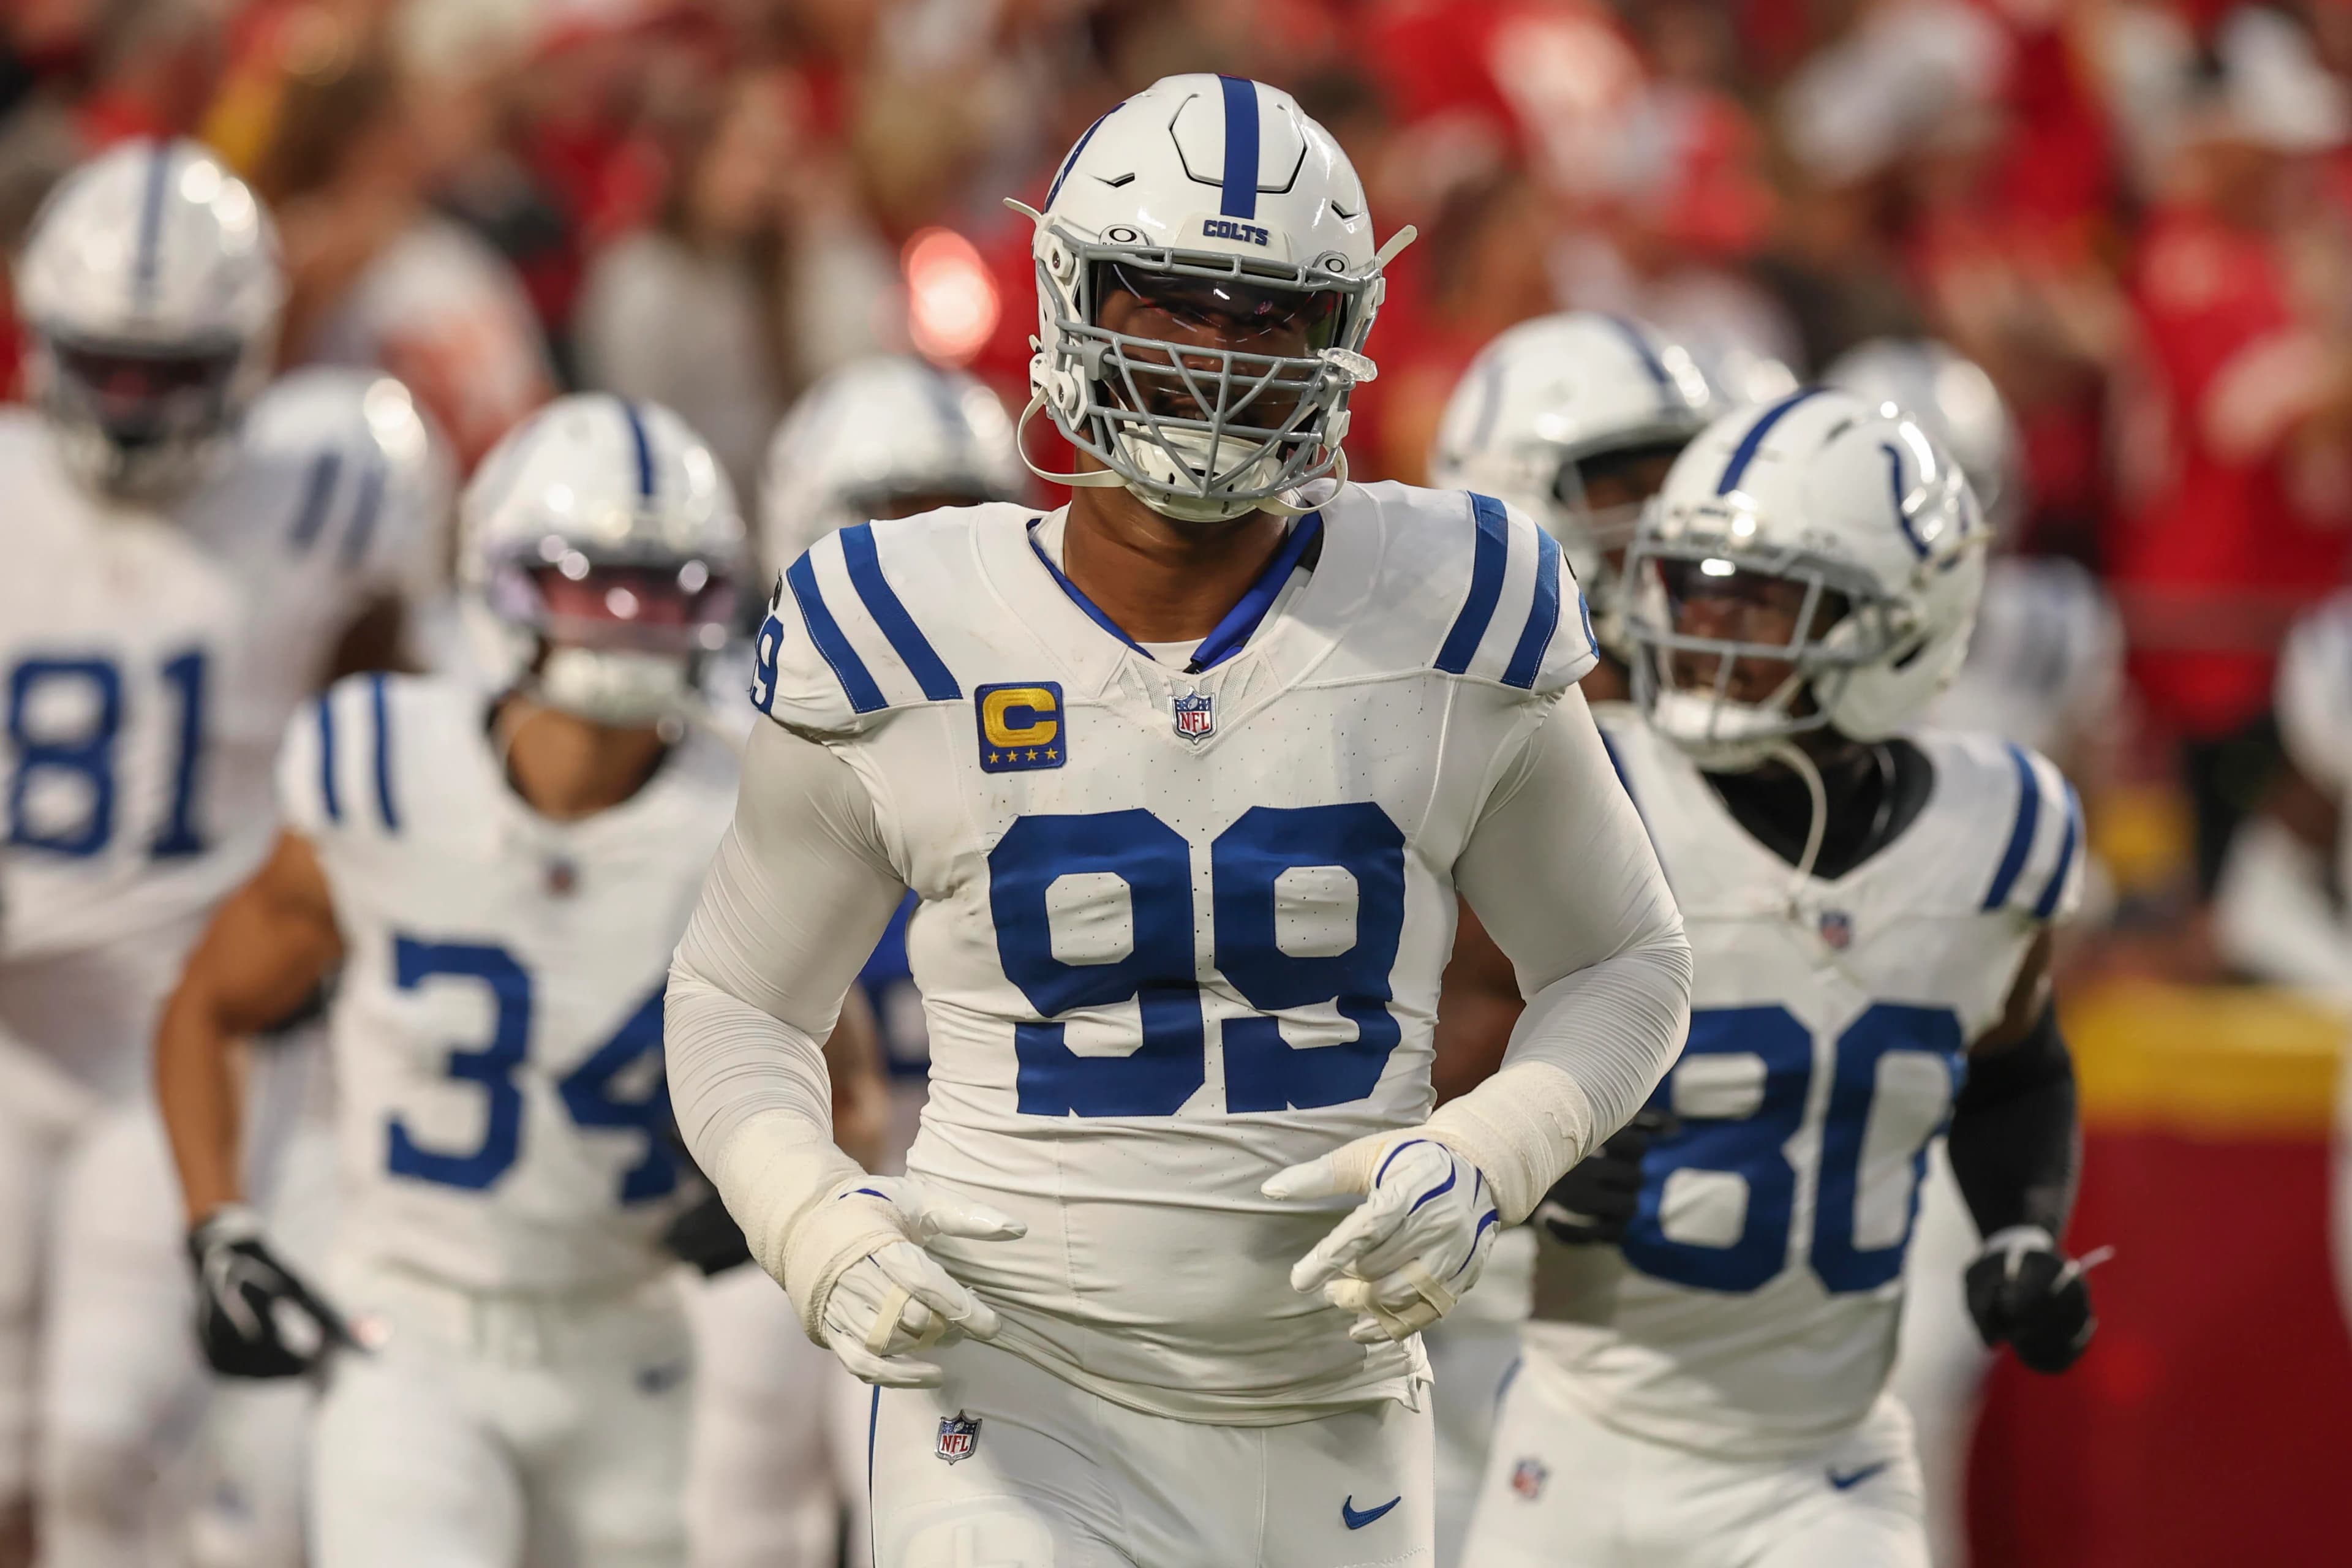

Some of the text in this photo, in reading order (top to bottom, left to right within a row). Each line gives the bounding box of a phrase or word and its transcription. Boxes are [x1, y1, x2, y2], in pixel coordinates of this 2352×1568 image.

[1202, 219, 1268, 246] COLTS
[9, 650, 205, 858] 81
[982, 688, 1057, 748] C
[1180, 712, 1209, 733] NFL
[987, 801, 1406, 1118] 99
[388, 932, 677, 1207] 34
[1621, 1000, 1967, 1296] 80
[941, 1434, 969, 1454] NFL
